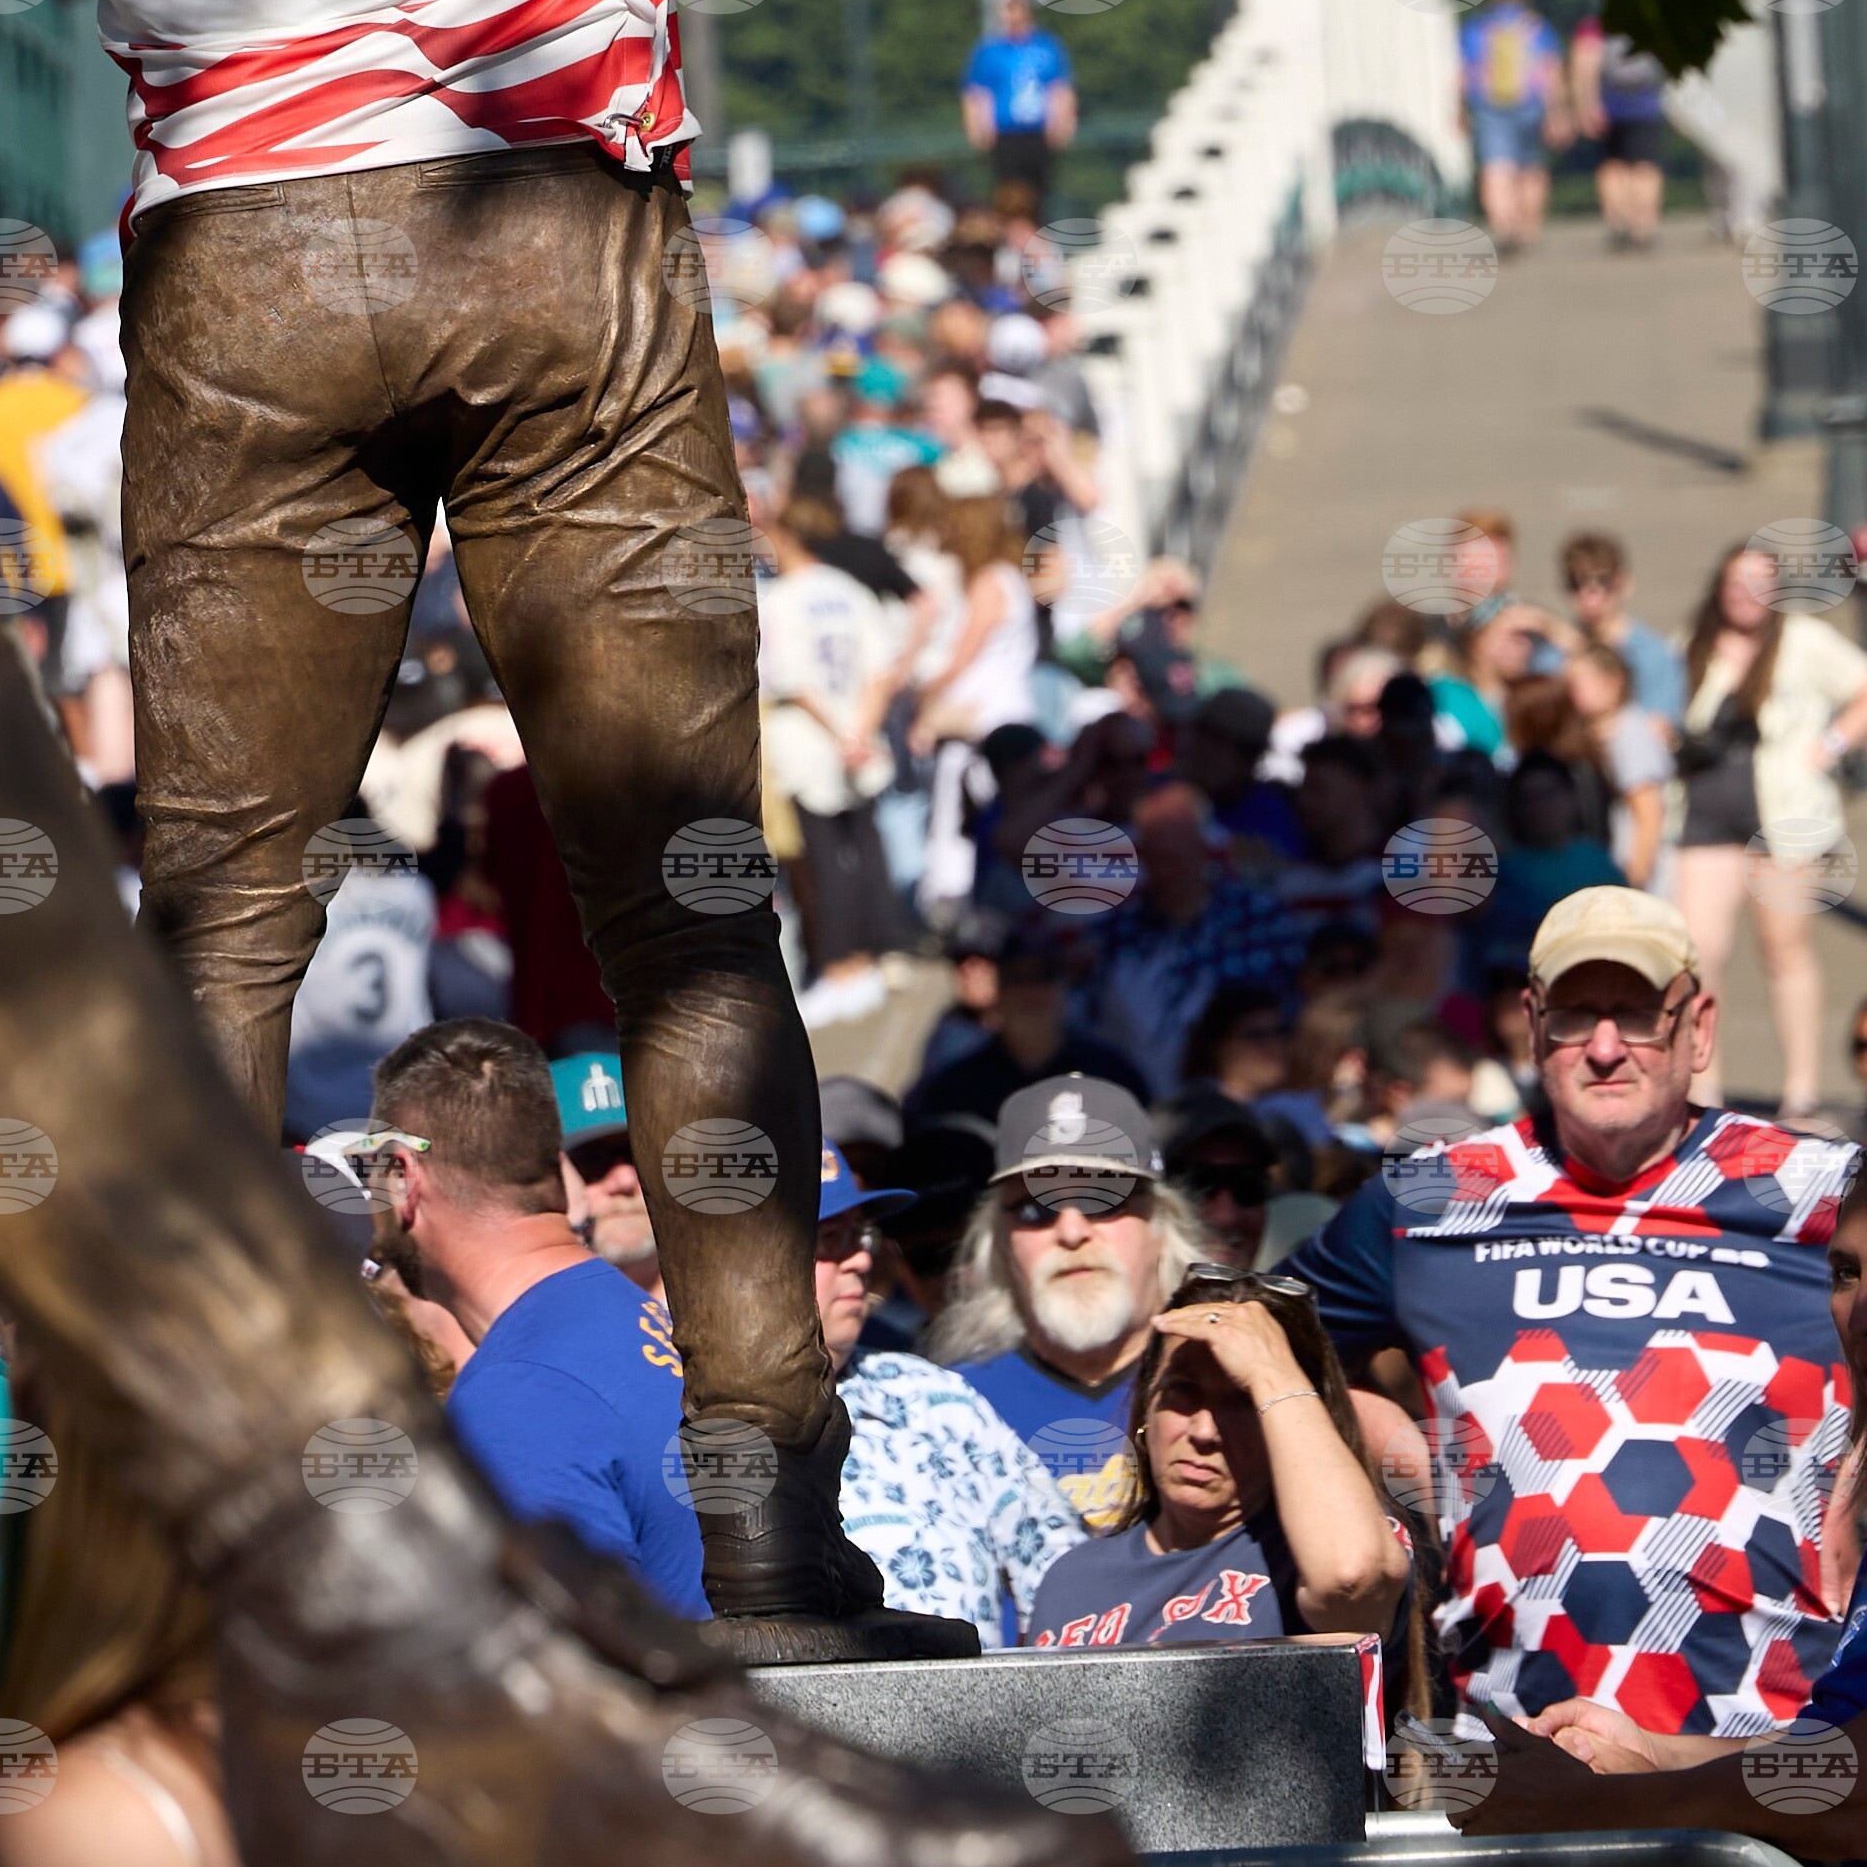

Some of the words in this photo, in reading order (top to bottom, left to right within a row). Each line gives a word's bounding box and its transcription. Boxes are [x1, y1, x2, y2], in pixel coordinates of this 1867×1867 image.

[1474, 1239, 1536, 1263] FIFA
[1537, 1234, 1644, 1256] WORLD
[1645, 1237, 1710, 1260] CUP
[1512, 1263, 1737, 1325] USA
